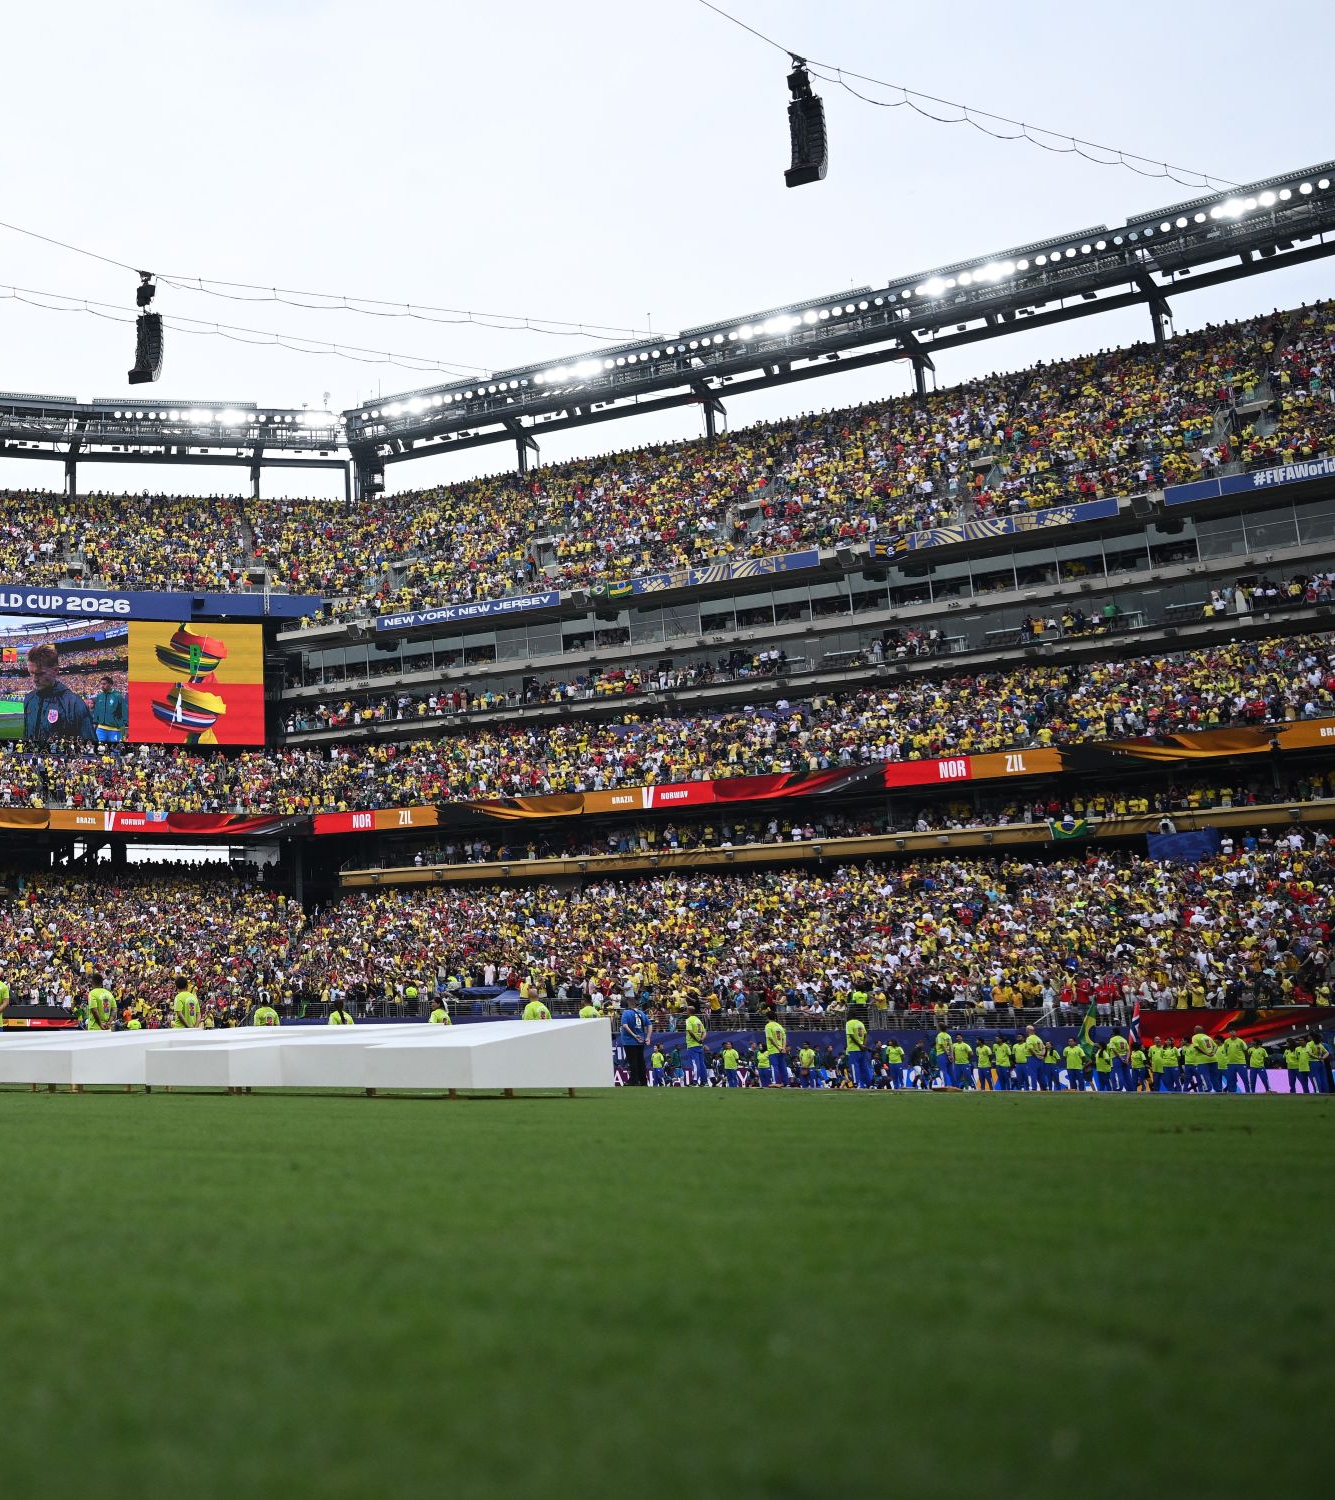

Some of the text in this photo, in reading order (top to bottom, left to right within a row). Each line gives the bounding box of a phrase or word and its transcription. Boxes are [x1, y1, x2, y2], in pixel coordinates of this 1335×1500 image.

[1253, 458, 1335, 486] #FIFAWorld
[26, 594, 63, 610] CUP
[66, 596, 131, 613] 2026
[384, 595, 551, 627] NEW YORK NEW JERSEY
[938, 753, 1027, 779] NOR ZIL
[611, 785, 689, 808] BRAZIL V NORWAY
[75, 811, 146, 832] BRAZIL V NORWAY
[352, 810, 413, 829] NOR ZIL
